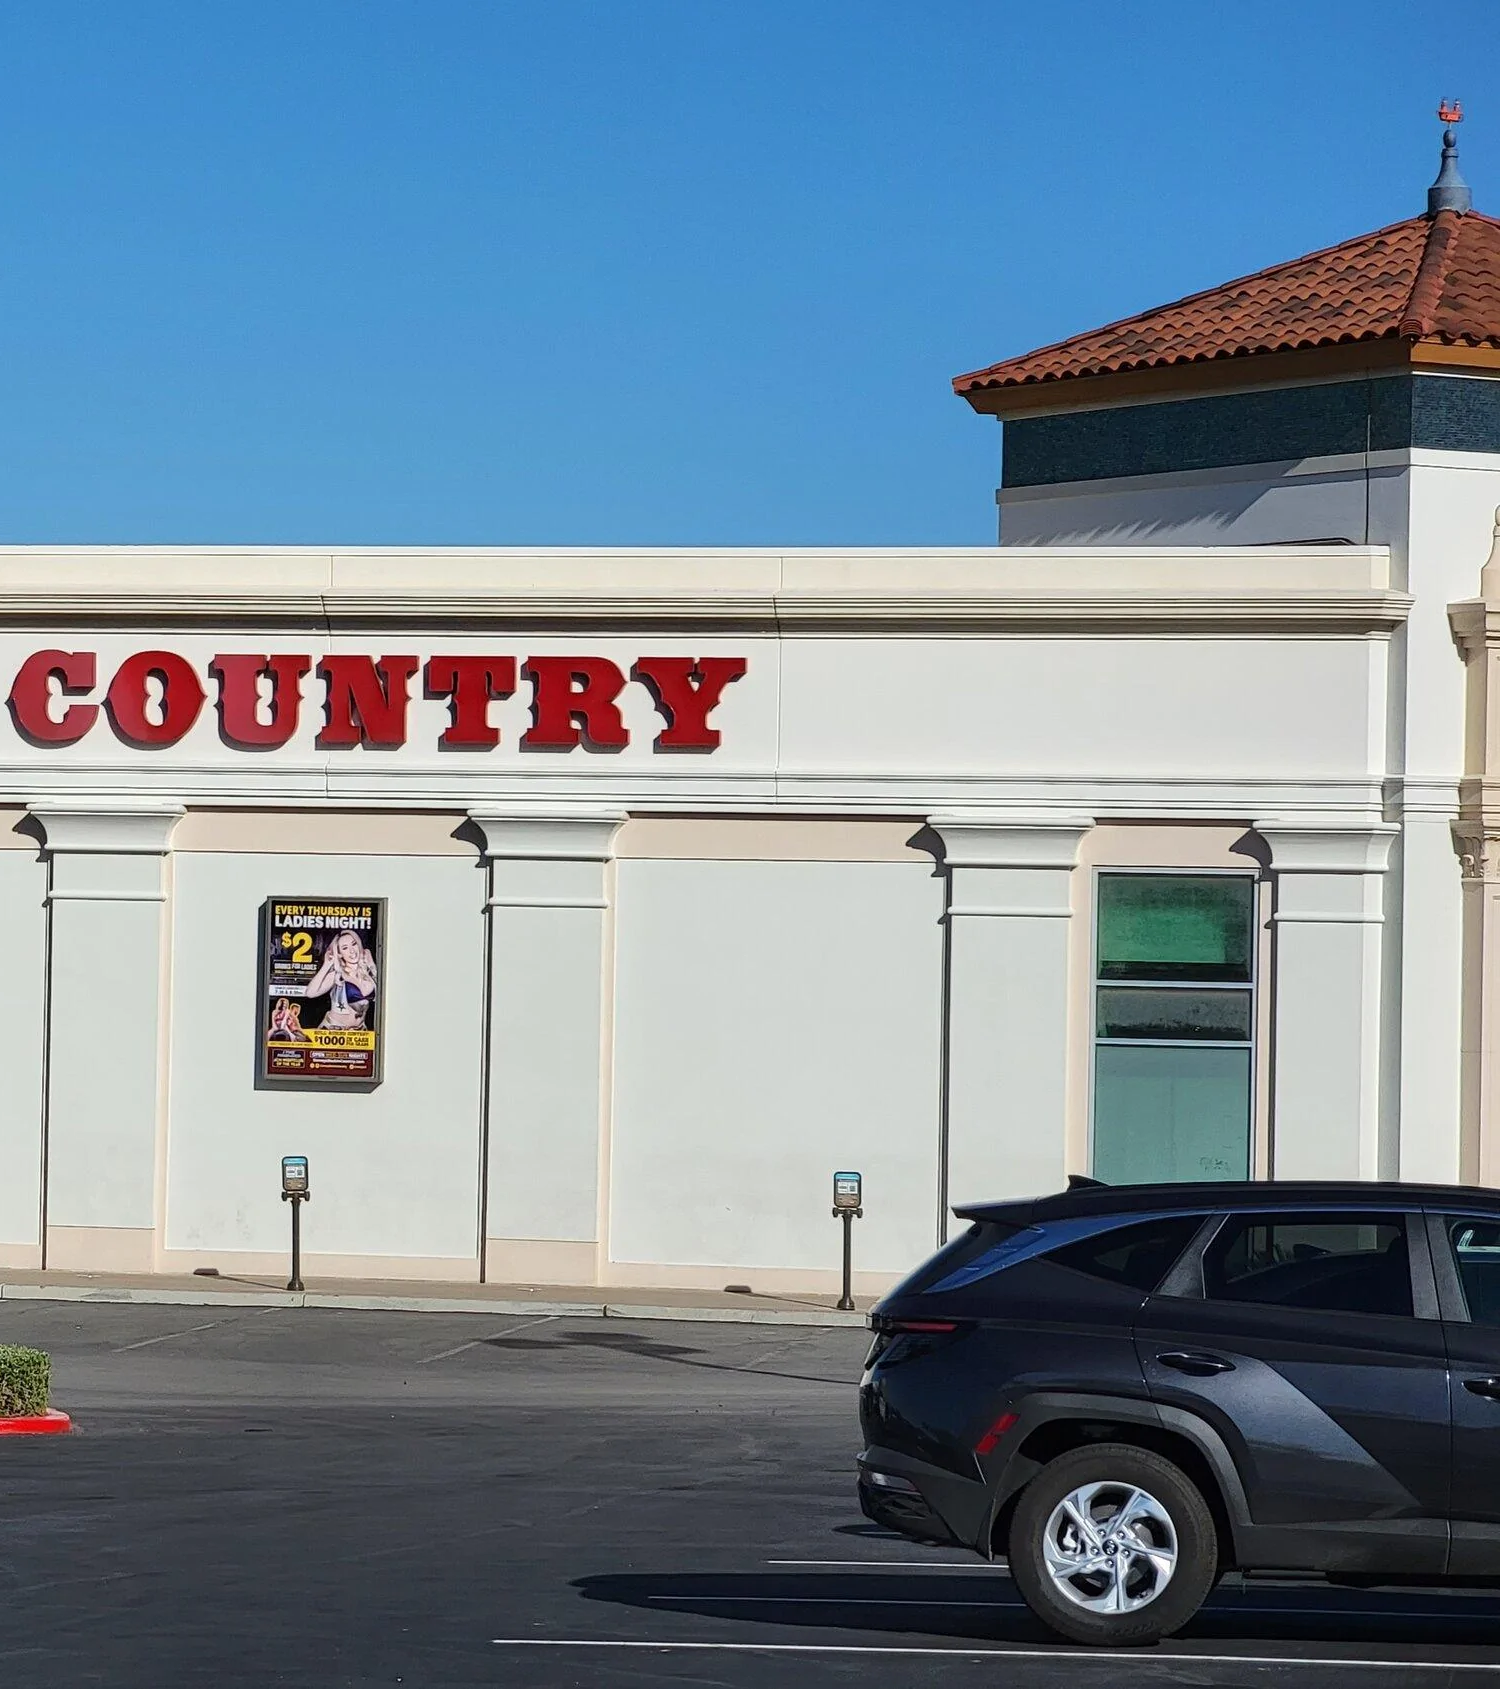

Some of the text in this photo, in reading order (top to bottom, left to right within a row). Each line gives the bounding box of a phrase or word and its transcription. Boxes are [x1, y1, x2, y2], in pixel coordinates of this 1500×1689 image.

[5, 649, 748, 754] COUNTRY
[275, 905, 372, 917] EVERY THURSDAY IS
[275, 915, 372, 930] LADIES NIGHT!
[281, 931, 313, 963] $2
